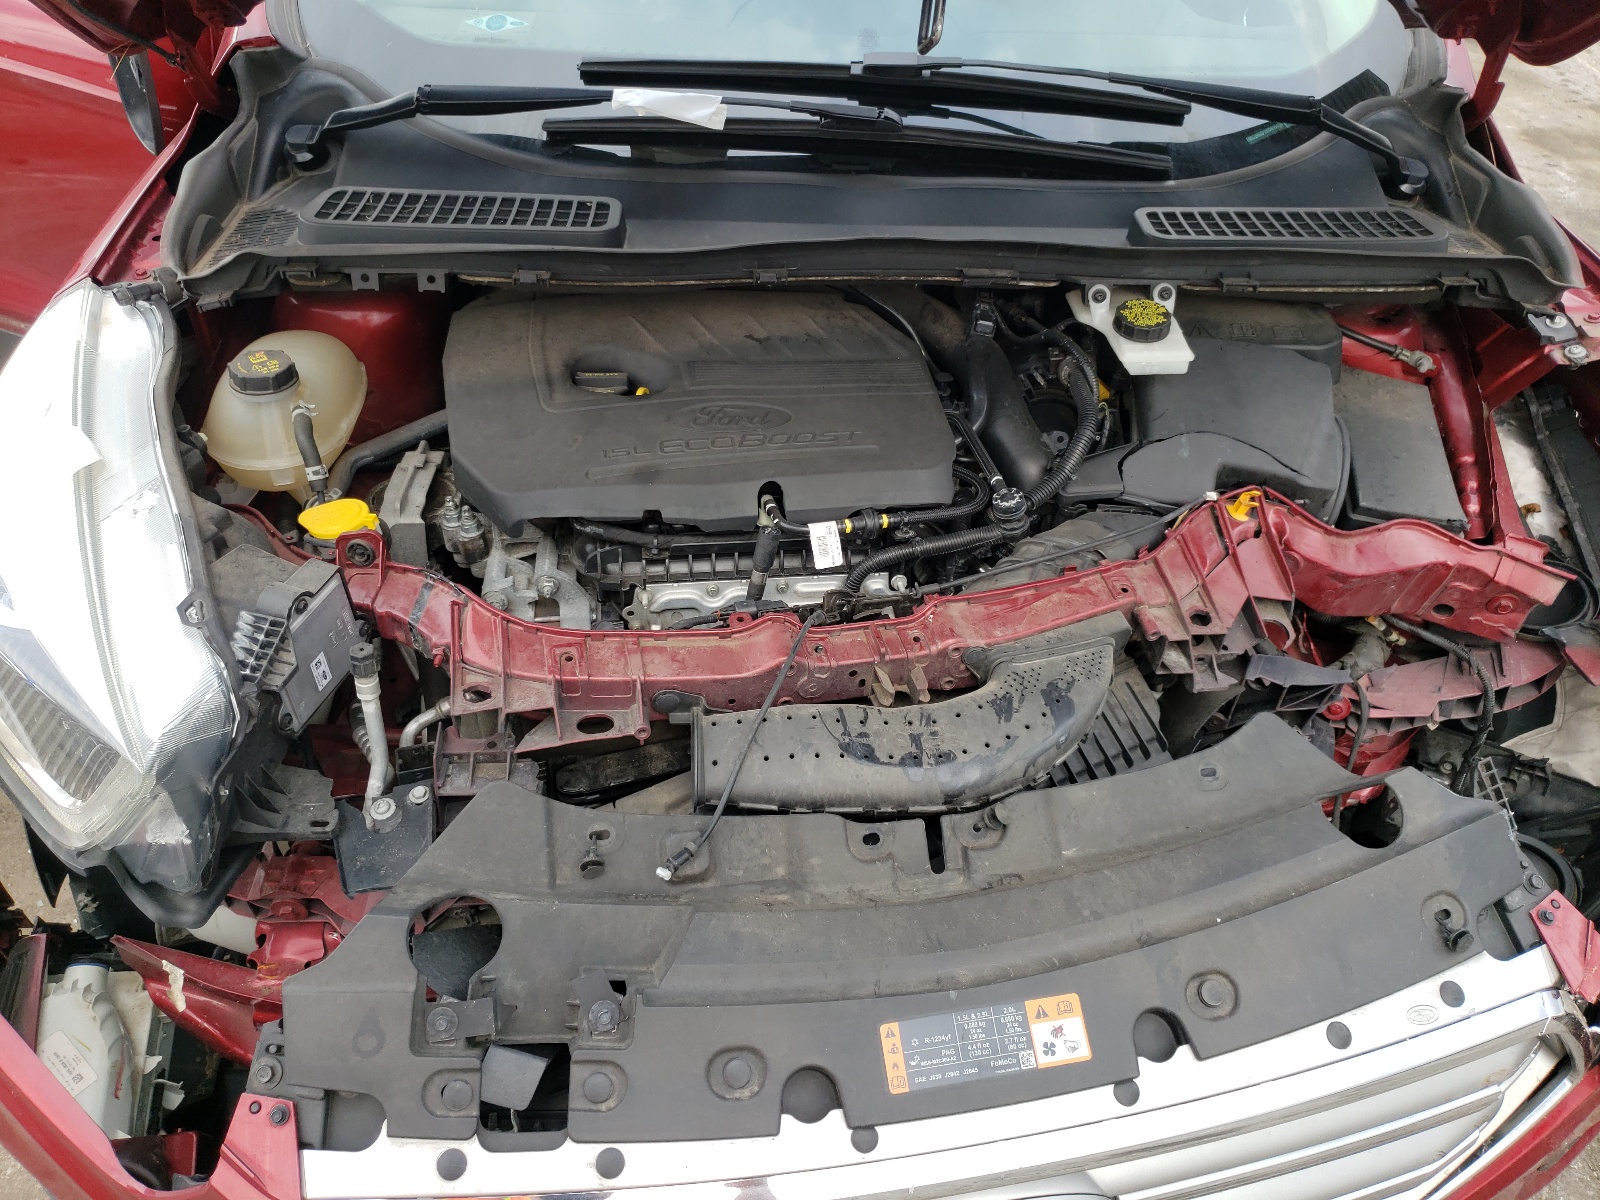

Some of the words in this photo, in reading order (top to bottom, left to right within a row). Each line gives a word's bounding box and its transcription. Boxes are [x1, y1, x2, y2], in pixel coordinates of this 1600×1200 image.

[692, 405, 772, 427] Ford
[1003, 1006, 1016, 1014] 2.0L
[957, 1012, 970, 1021] 1.5L
[924, 1034, 951, 1044] R-1234yf
[941, 1048, 955, 1056] PAG
[969, 1050, 981, 1058] (130
[990, 1057, 1016, 1067] FoMoCo
[914, 1076, 927, 1084] SAE
